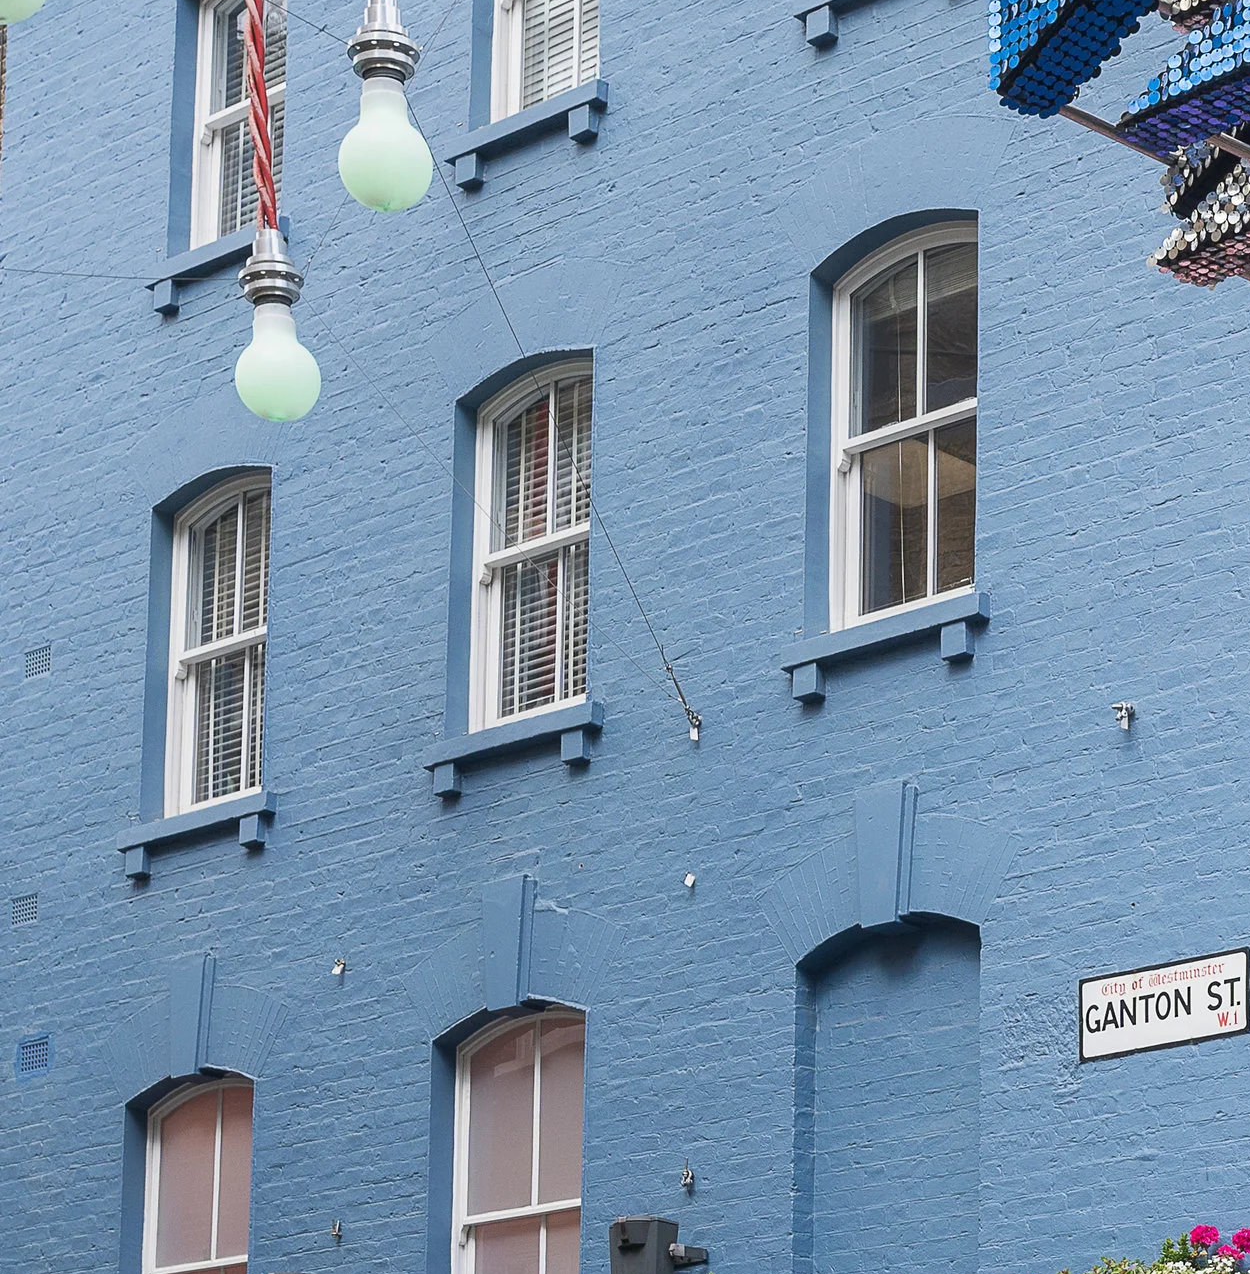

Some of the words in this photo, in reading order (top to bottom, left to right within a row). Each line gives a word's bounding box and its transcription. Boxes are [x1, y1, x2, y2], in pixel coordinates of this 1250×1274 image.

[1101, 982, 1126, 996] City
[1131, 976, 1144, 991] of
[1148, 962, 1225, 987] Westminster
[1085, 986, 1192, 1034] GANTON
[1207, 977, 1241, 1011] ST.
[1217, 1010, 1239, 1028] W.1
